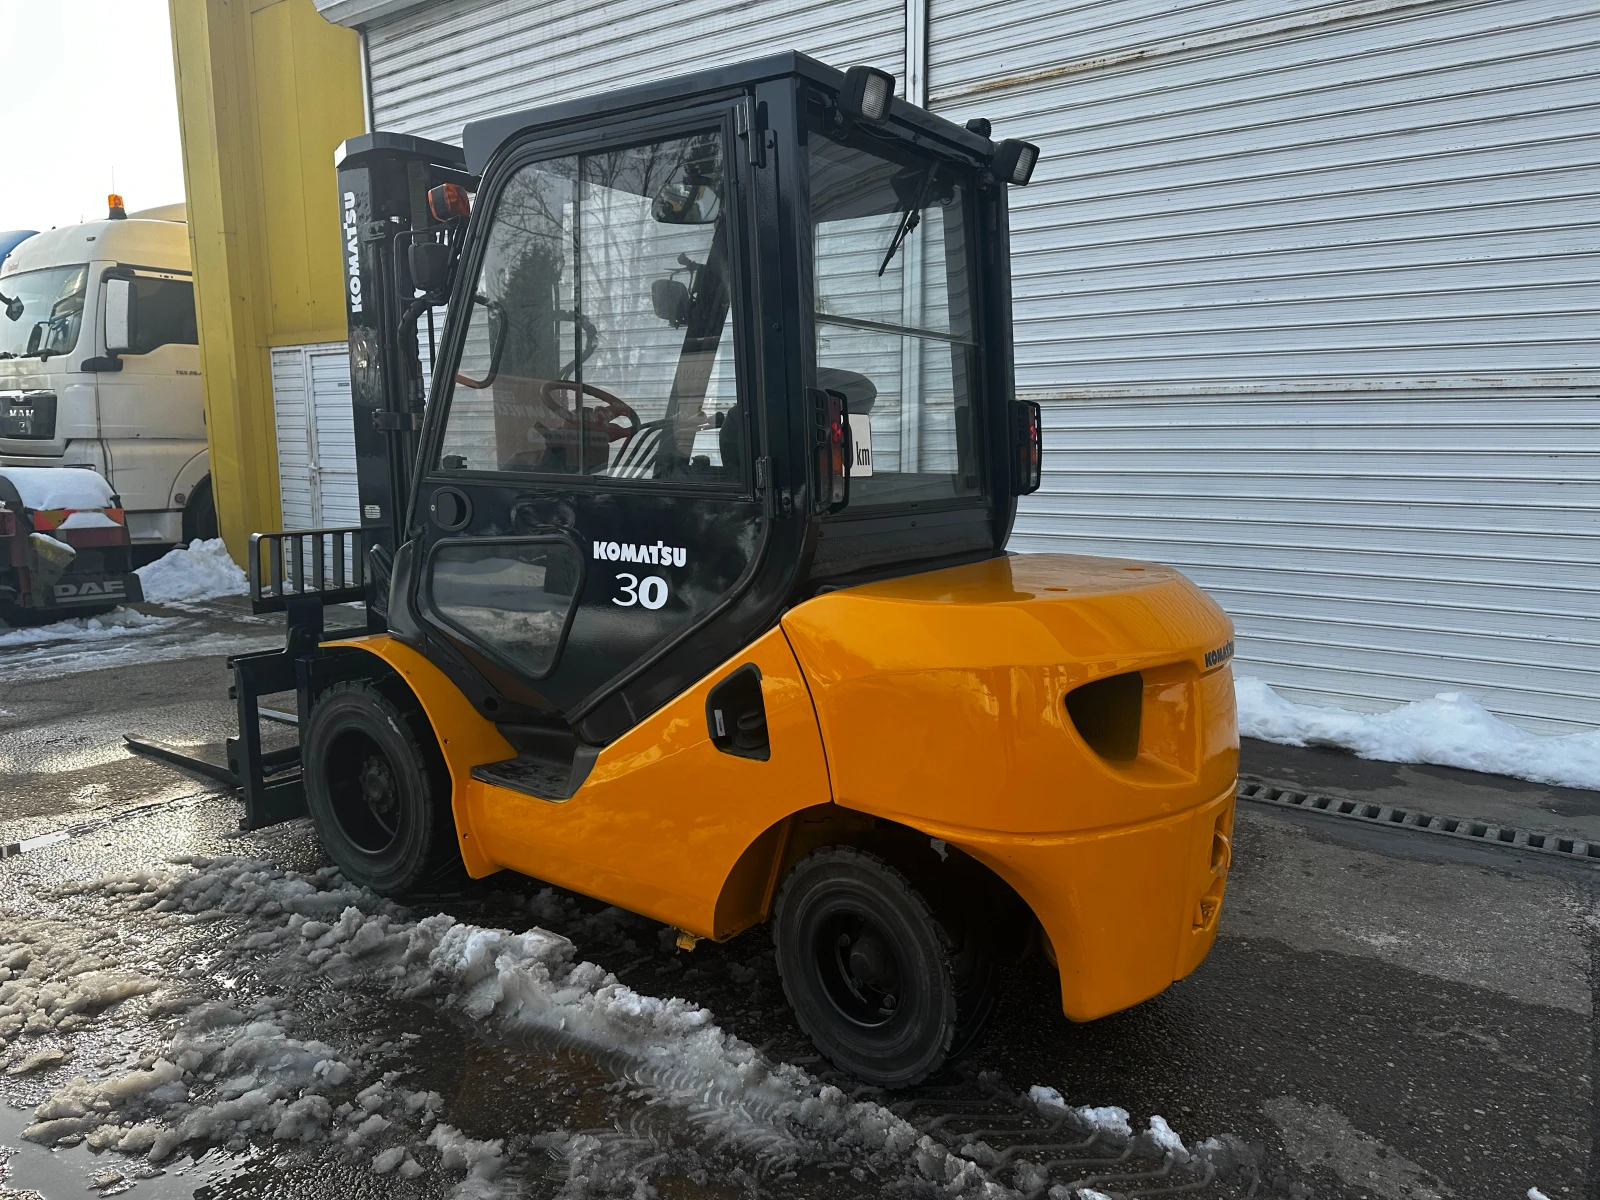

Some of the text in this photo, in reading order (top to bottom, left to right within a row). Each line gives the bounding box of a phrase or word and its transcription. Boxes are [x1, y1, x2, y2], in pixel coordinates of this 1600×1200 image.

[343, 191, 362, 312] KOMATSU
[856, 440, 870, 466] km
[593, 540, 687, 568] KOMATSU
[53, 580, 124, 597] DAF
[611, 572, 669, 610] 30
